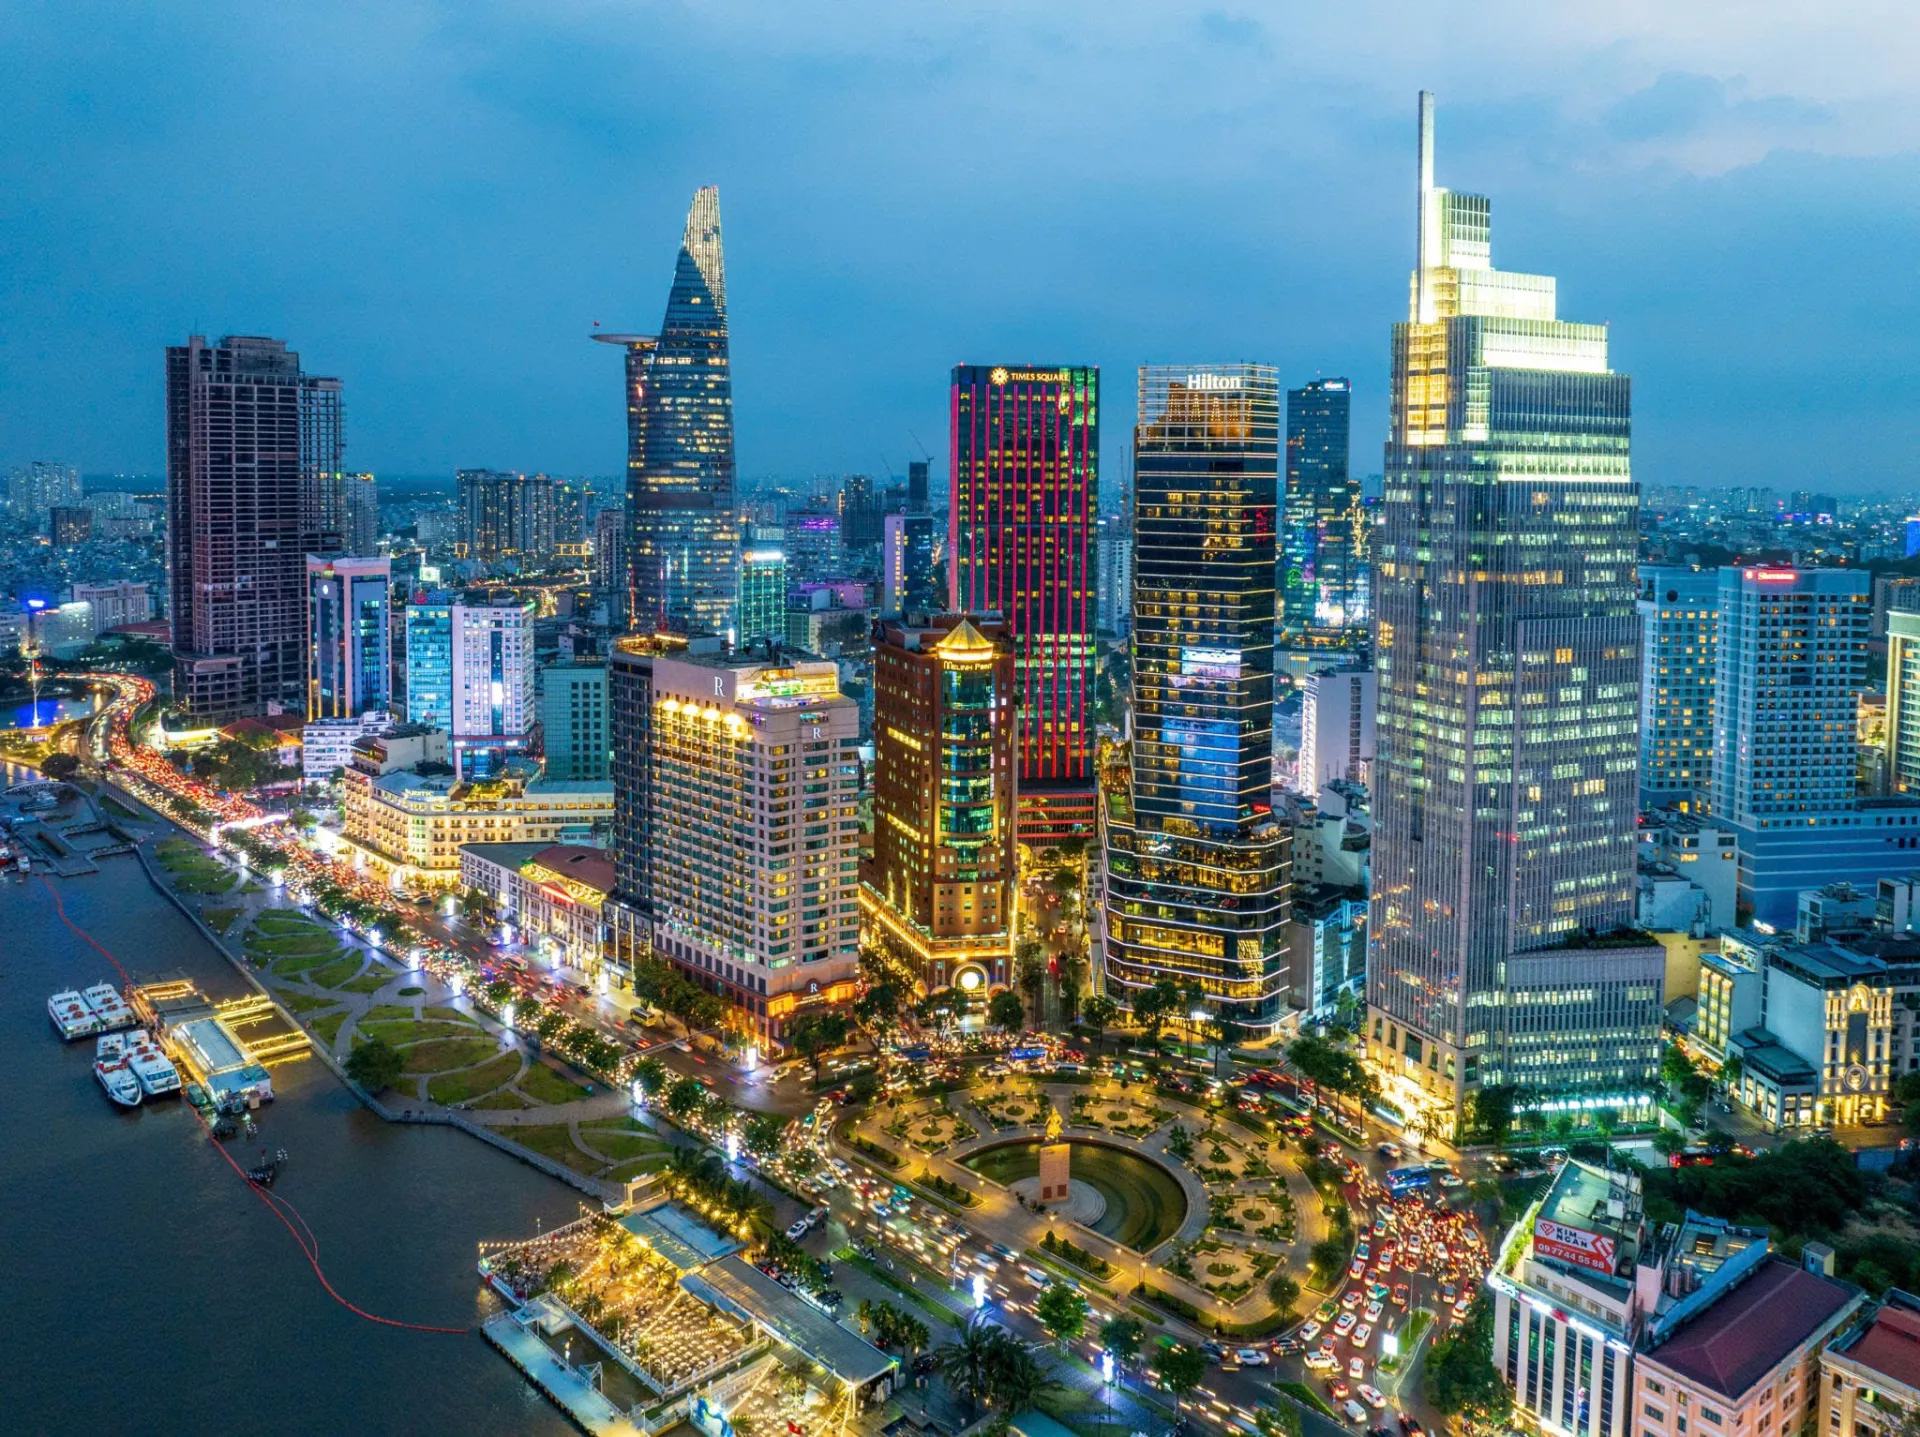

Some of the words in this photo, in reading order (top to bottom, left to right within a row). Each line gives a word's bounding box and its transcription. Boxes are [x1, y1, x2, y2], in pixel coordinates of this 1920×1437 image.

[1010, 372, 1035, 381] TIMES
[1036, 372, 1068, 383] SQUARE
[1187, 373, 1241, 390] Hilton
[1757, 571, 1795, 581] Sheraton
[714, 676, 726, 698] R
[812, 727, 822, 739] R
[810, 983, 818, 993] R
[1556, 1226, 1577, 1238] KIM
